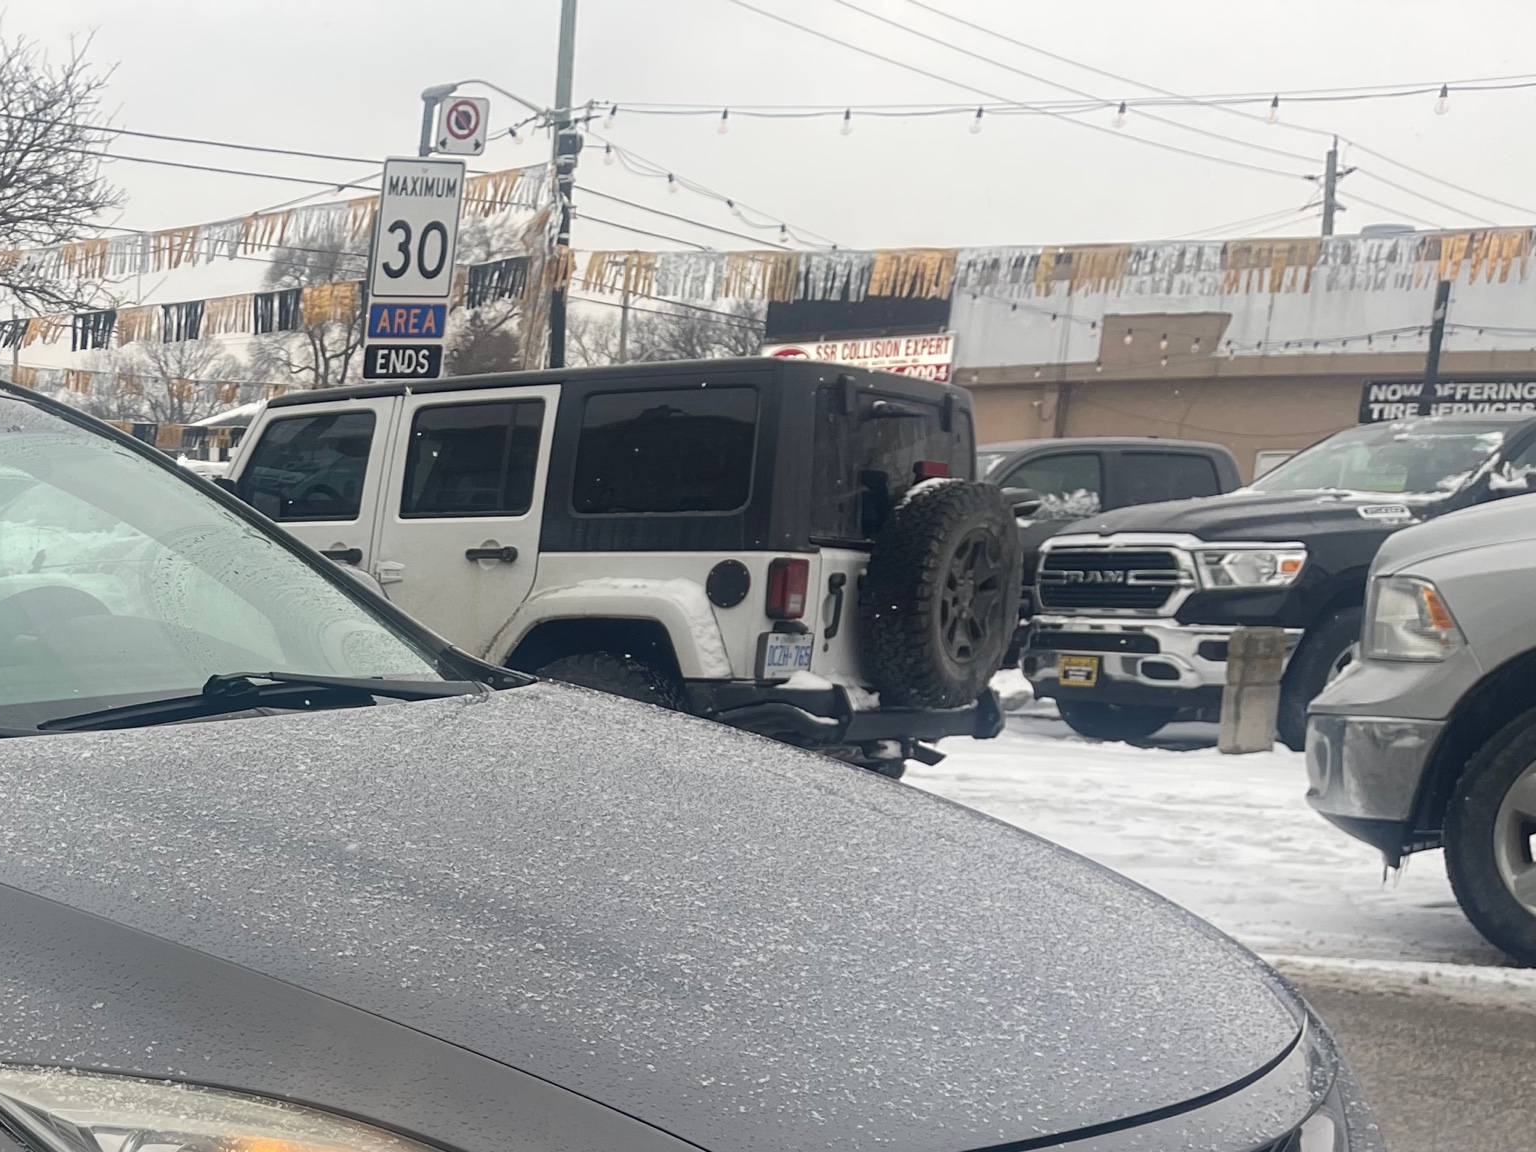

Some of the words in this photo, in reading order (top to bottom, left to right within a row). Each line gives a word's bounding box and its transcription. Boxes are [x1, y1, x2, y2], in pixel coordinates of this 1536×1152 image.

[388, 175, 458, 198] MAXIMUM
[382, 219, 448, 280] 30
[376, 308, 436, 333] AREA
[375, 349, 430, 374] ENDS
[816, 345, 837, 362] SSR
[842, 341, 901, 360] COLLISION
[905, 337, 950, 356] EXPERT
[1369, 384, 1424, 402] NOW
[1370, 403, 1419, 420] TIRE
[1067, 570, 1124, 582] RAM
